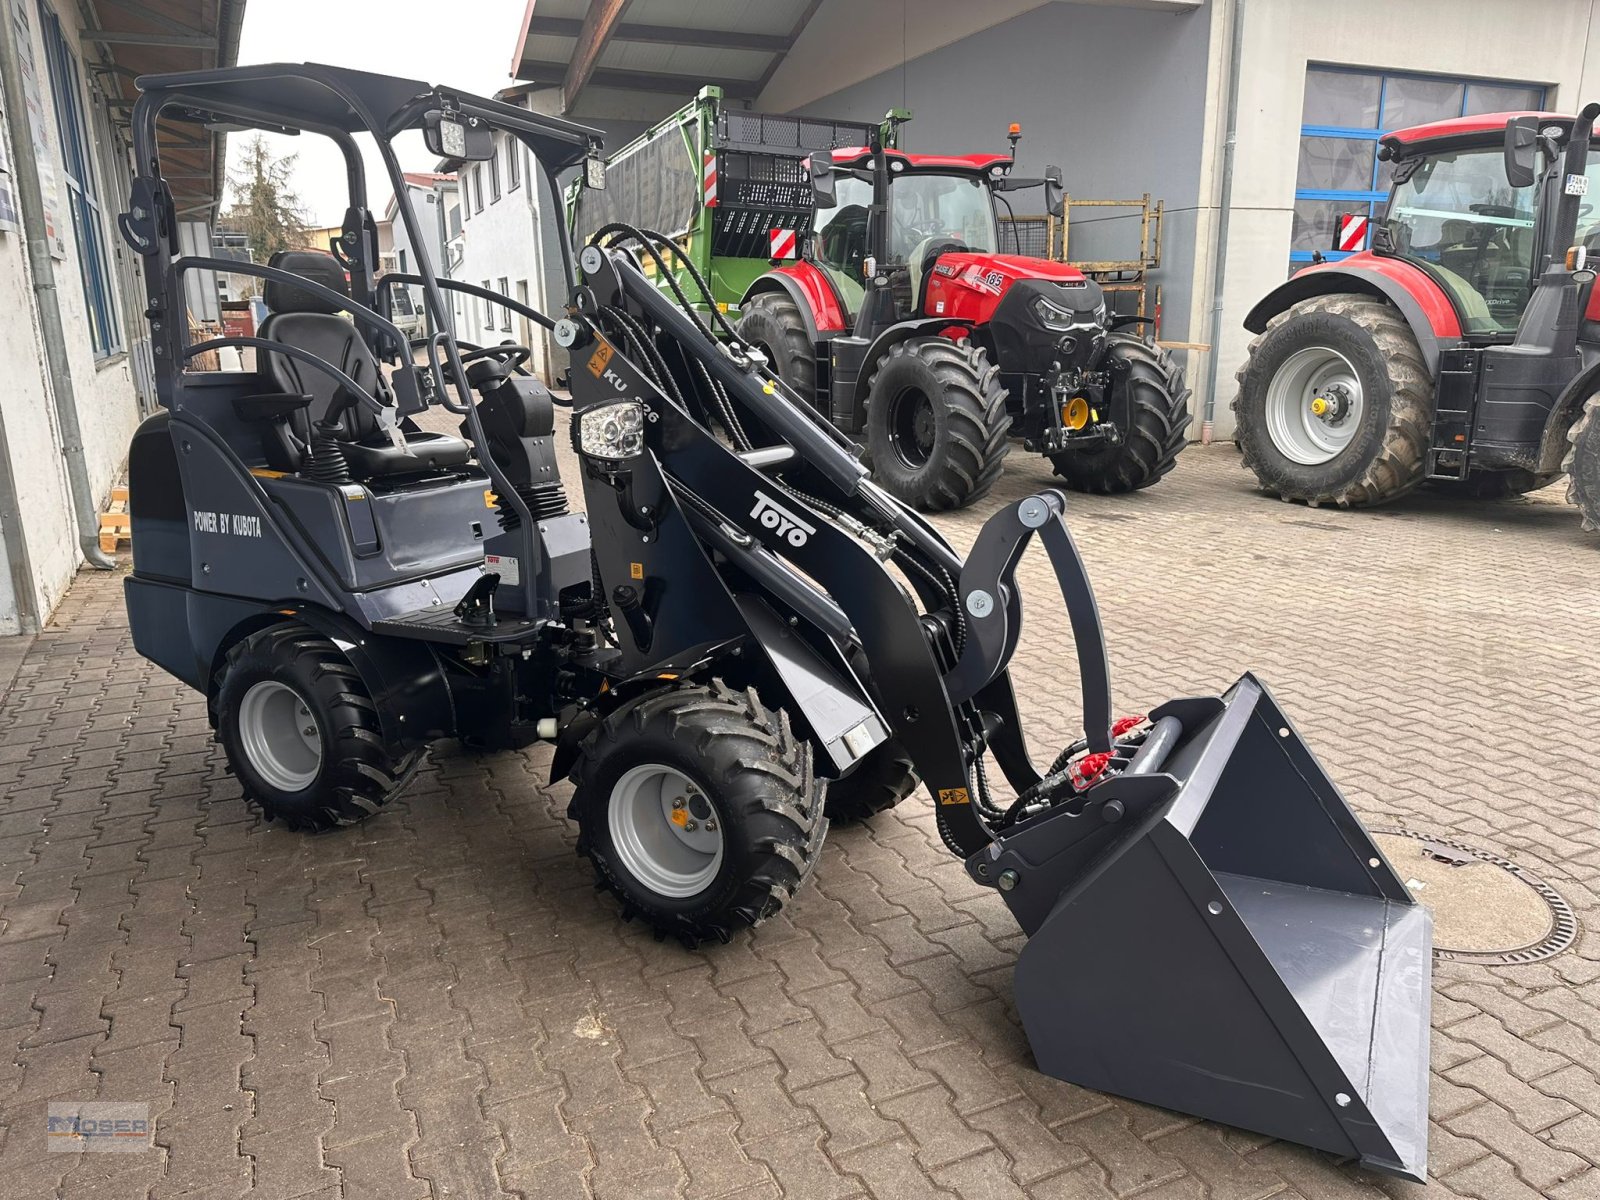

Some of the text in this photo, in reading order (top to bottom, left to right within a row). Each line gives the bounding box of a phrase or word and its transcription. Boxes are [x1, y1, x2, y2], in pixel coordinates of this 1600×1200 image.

[985, 273, 1002, 287] 185
[603, 368, 628, 392] KU
[194, 511, 261, 538] POWER BY KUBOTA
[749, 490, 817, 548] TOYO
